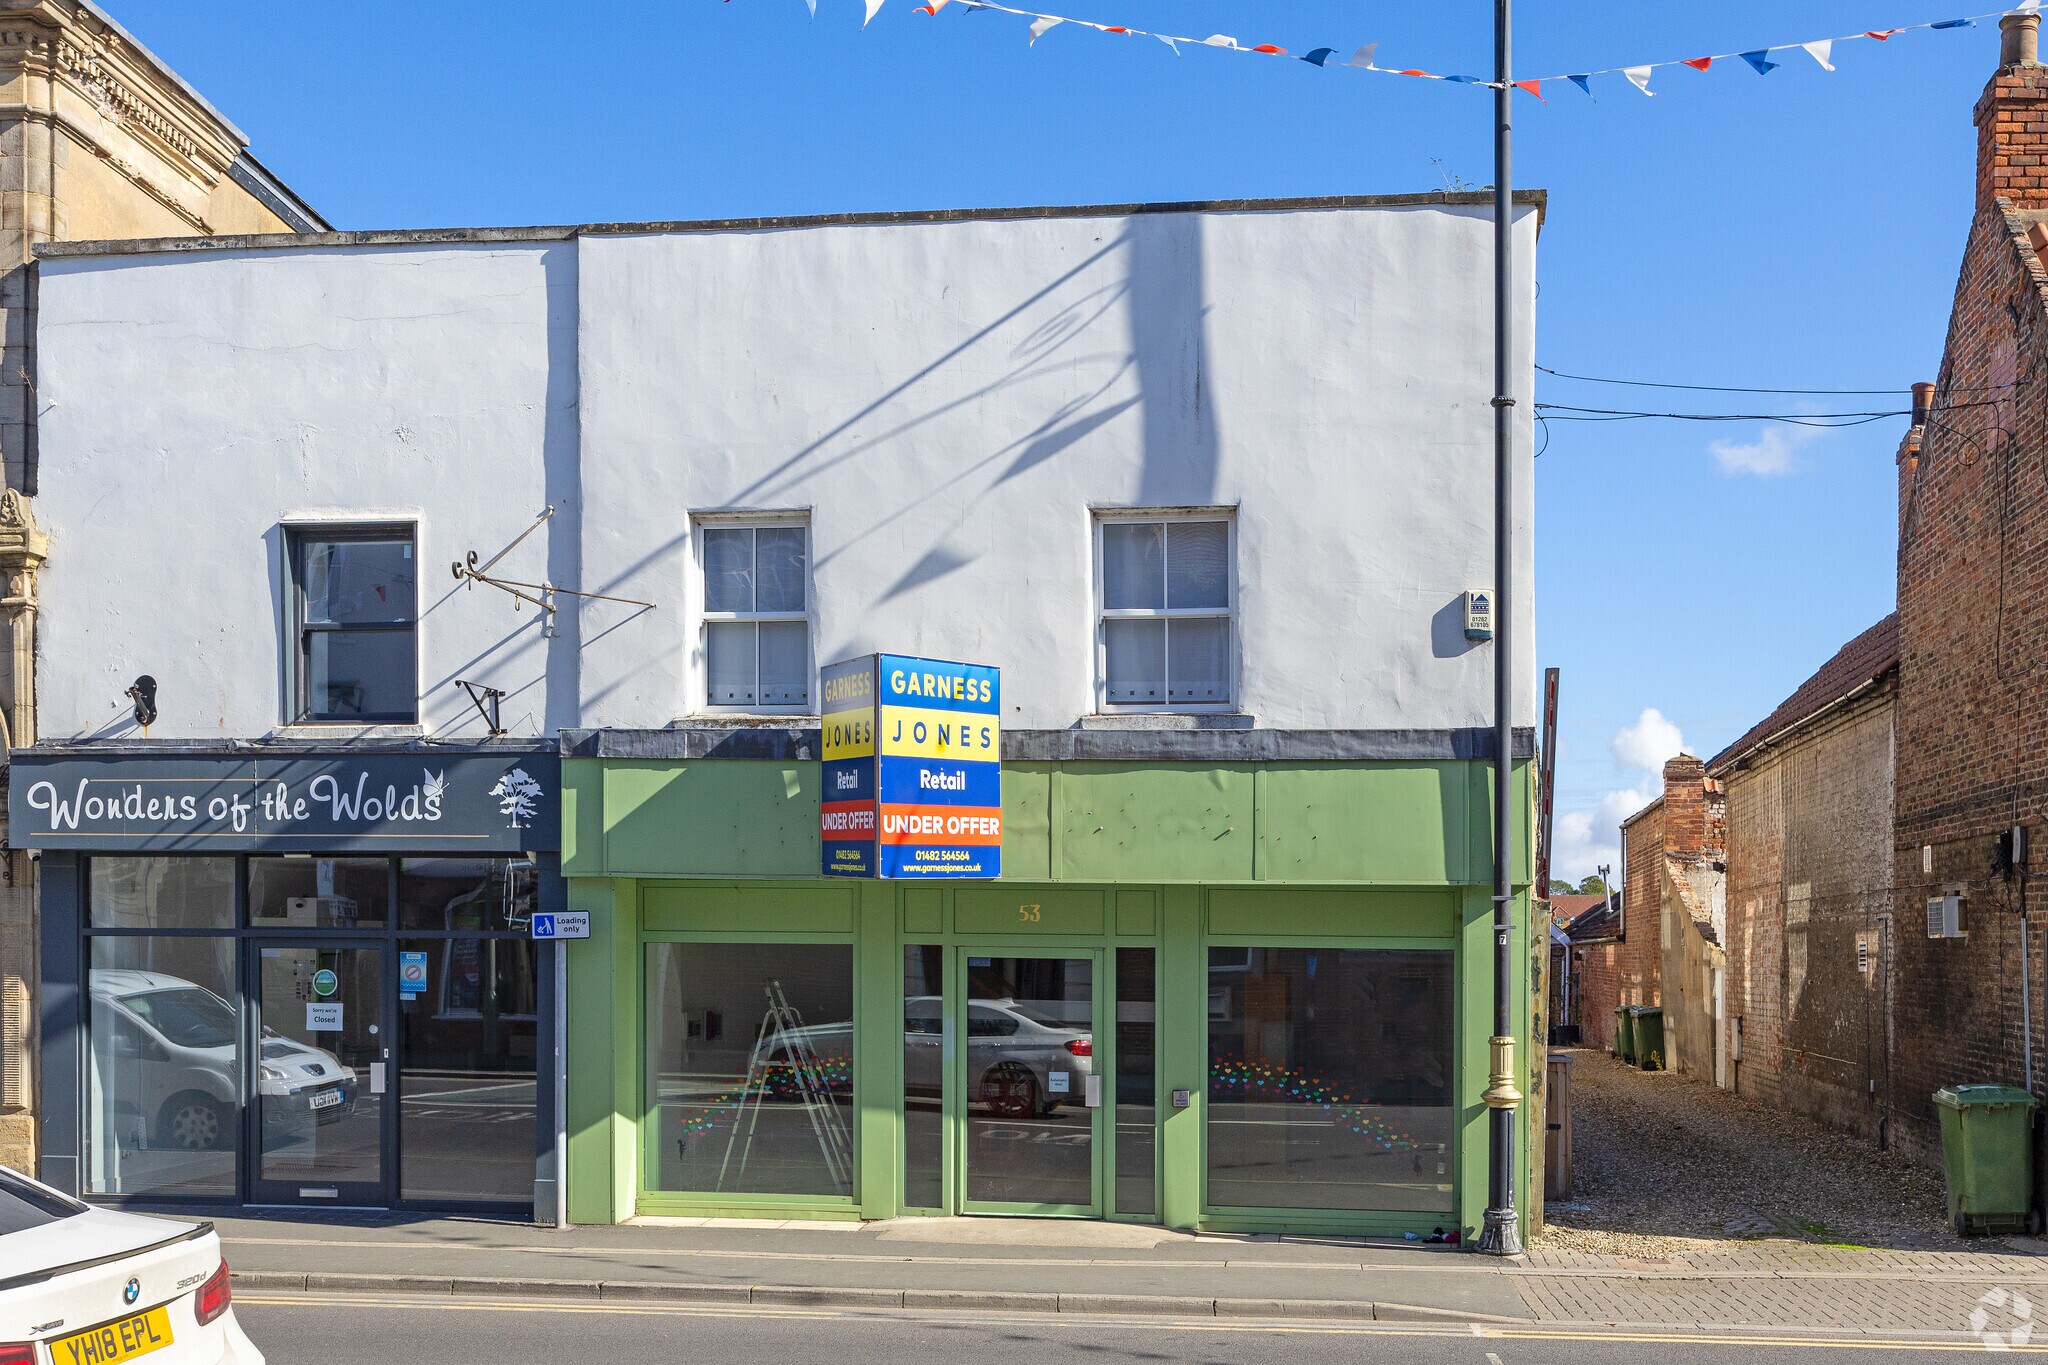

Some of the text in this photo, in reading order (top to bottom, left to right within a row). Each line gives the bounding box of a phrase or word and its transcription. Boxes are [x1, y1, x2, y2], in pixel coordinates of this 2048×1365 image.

[825, 671, 871, 703] GARNESS
[890, 669, 992, 703] GARNESS
[825, 720, 871, 749] JONES
[891, 719, 991, 749] JONES
[837, 769, 858, 790] Retail
[919, 768, 966, 791] Retail
[26, 771, 443, 832] Wonders of the Wolds
[822, 810, 875, 830] UNDER OFFER
[883, 813, 1000, 836] UNDER OFFER
[915, 850, 970, 862] 01482 564564
[902, 863, 982, 875] www.garnessjones.co.uk
[556, 916, 587, 925] Loading
[1018, 904, 1041, 923] 53
[563, 925, 580, 933] only
[1500, 935, 1506, 944] 7
[176, 1270, 207, 1290] 320d
[66, 1314, 161, 1365] YH18 EPL
